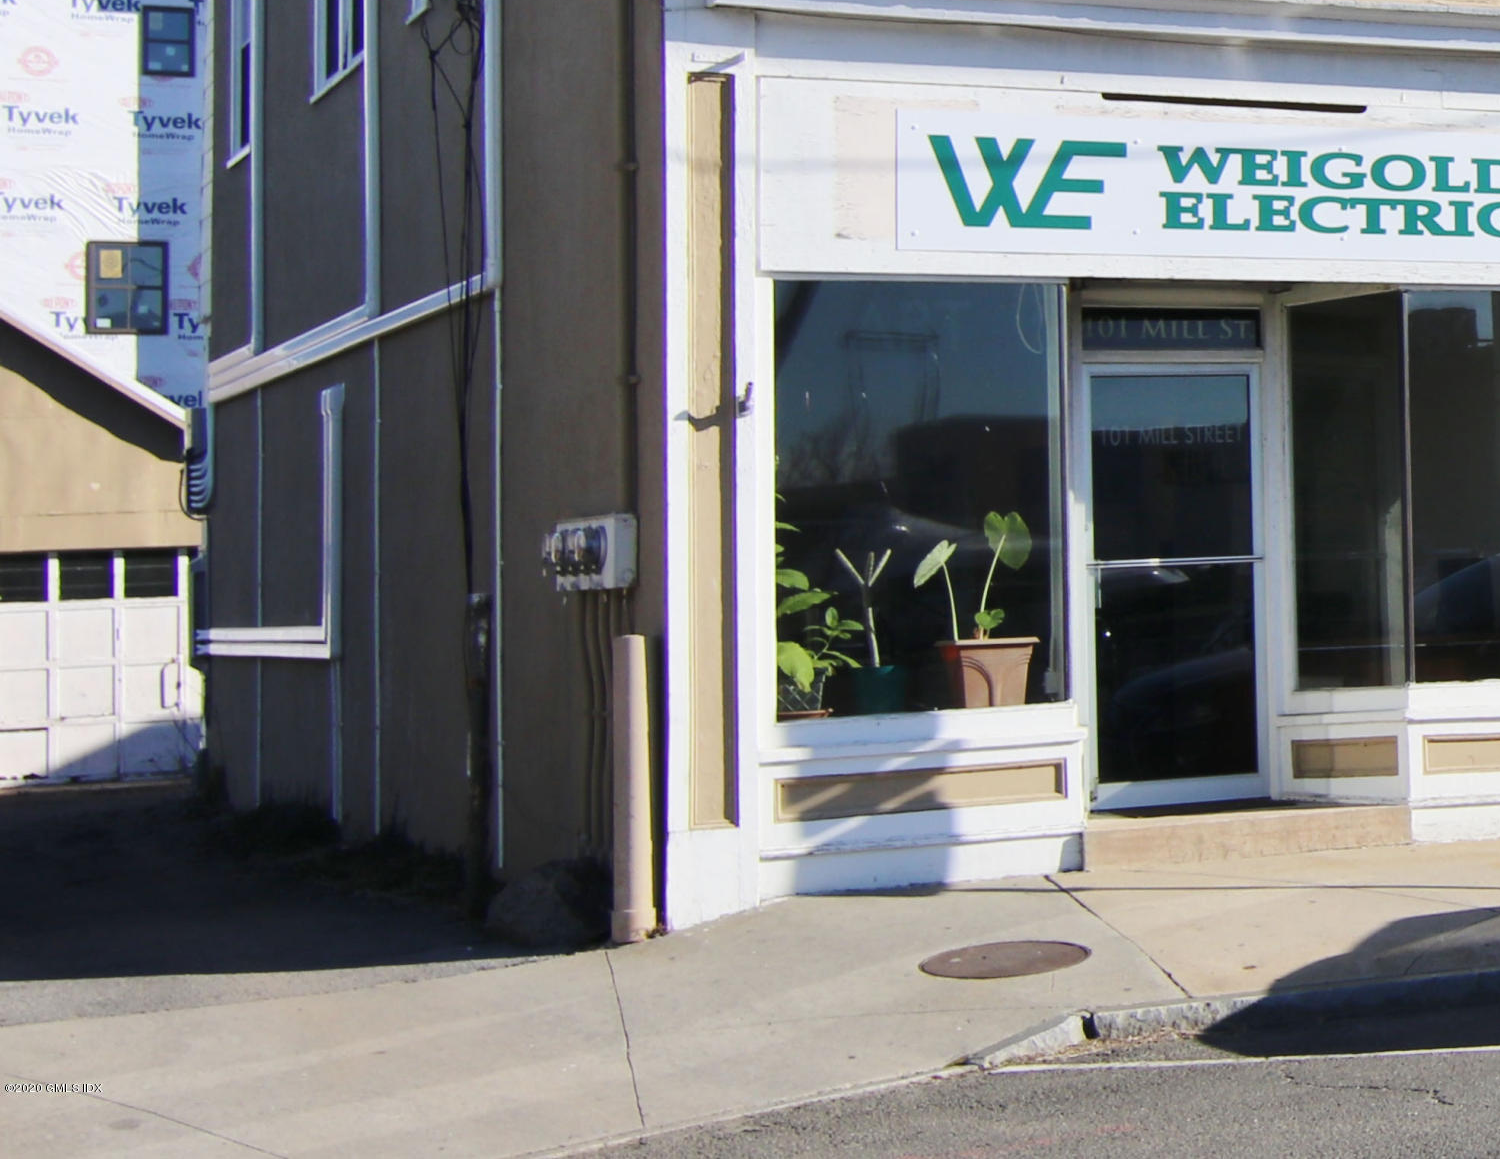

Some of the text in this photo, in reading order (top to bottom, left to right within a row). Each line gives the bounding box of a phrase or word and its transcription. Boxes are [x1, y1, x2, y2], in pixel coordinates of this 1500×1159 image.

[2, 105, 79, 127] Tyvek
[128, 110, 202, 131] Tyvek
[0, 192, 64, 213] yvek
[113, 196, 188, 217] Tyvek
[1086, 316, 1127, 339] 101
[1140, 318, 1208, 339] MILL
[1100, 423, 1243, 447] 101 MILL STREET
